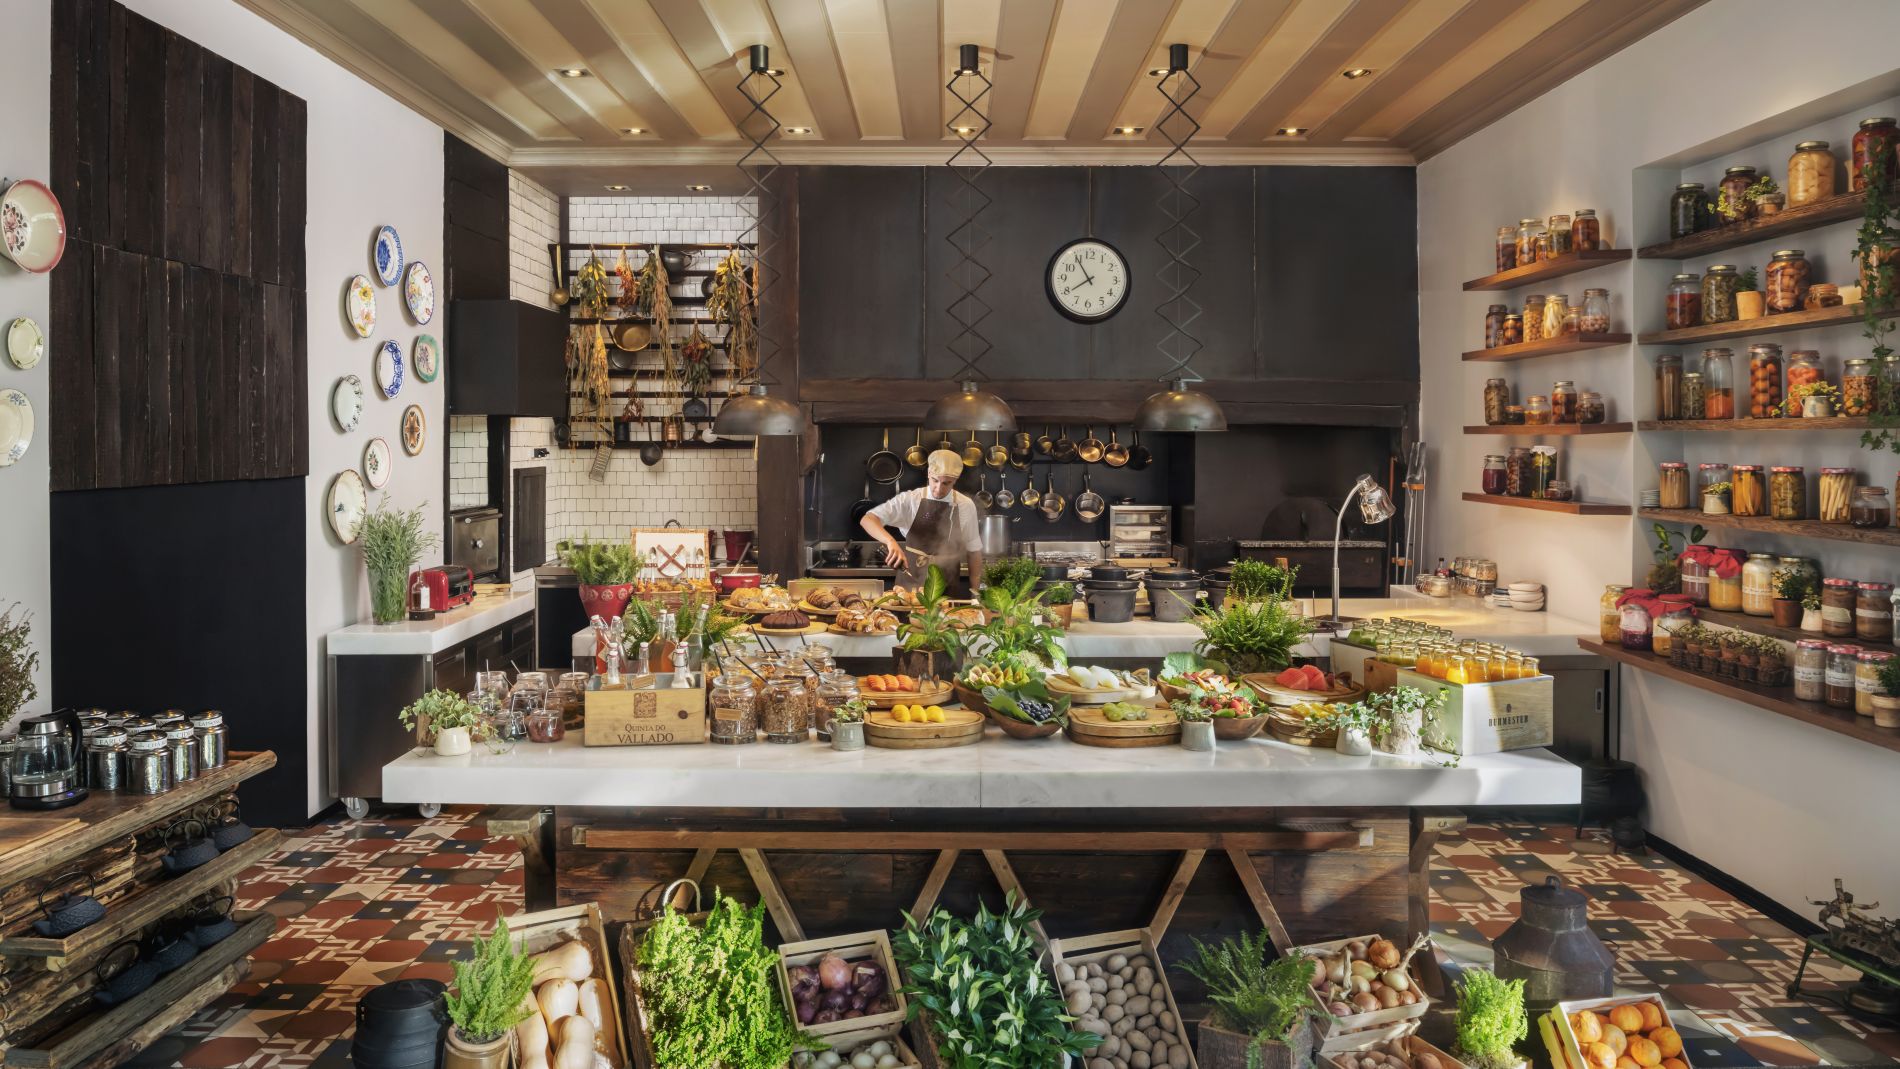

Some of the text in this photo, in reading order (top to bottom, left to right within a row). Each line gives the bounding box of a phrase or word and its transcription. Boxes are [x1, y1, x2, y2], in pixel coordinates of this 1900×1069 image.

[1085, 251, 1095, 260] 12
[1066, 264, 1075, 272] 10
[1108, 263, 1114, 272] 2
[1061, 274, 1067, 282] 9
[1113, 276, 1118, 285] 3
[1063, 286, 1070, 295] 8
[1107, 288, 1113, 296] 4
[1074, 295, 1080, 305] 7
[1085, 300, 1092, 308] 6
[1099, 297, 1105, 306] 5
[617, 733, 674, 744] VALLADO
